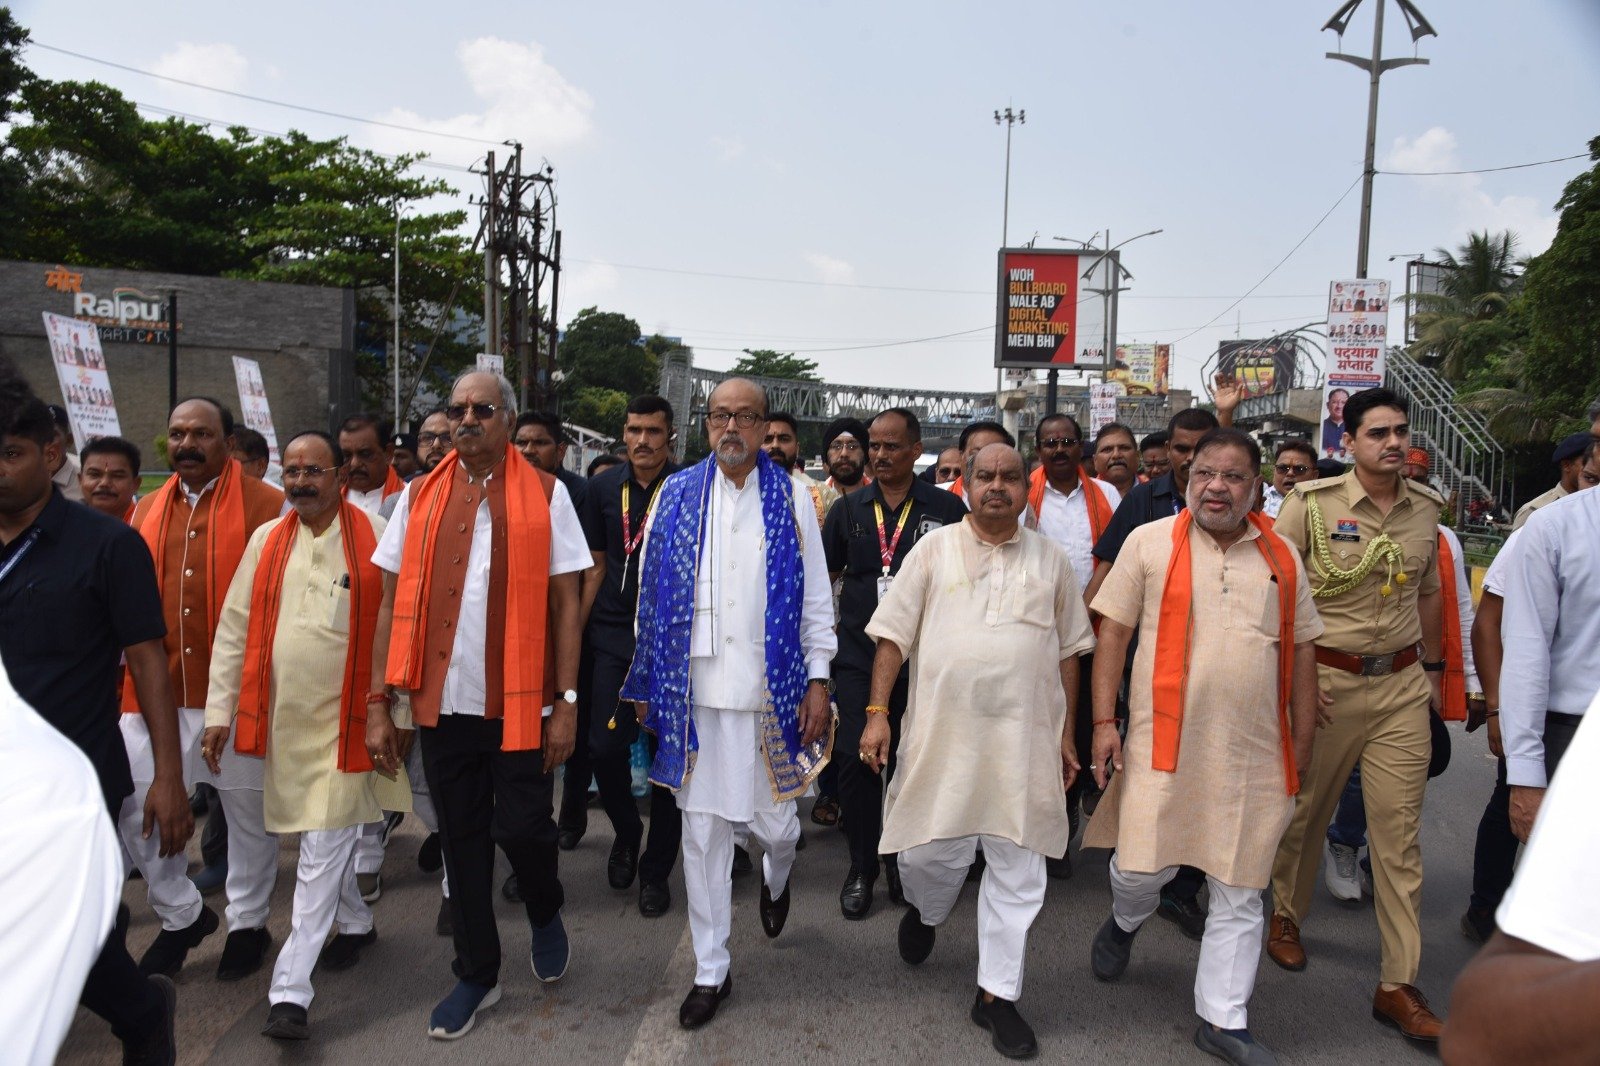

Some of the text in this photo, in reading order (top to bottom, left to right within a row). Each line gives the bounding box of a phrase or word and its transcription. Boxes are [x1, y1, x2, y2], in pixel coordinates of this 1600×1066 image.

[1010, 268, 1034, 281] WOH
[1009, 282, 1067, 295] BILLBOARD
[1009, 295, 1055, 308] WALE AB
[1008, 308, 1048, 321] DIGITAL
[1008, 321, 1069, 335] MARKETING
[97, 328, 133, 342] MART
[1008, 334, 1055, 348] MEIN BHI
[1334, 347, 1379, 359] पदयात्रा
